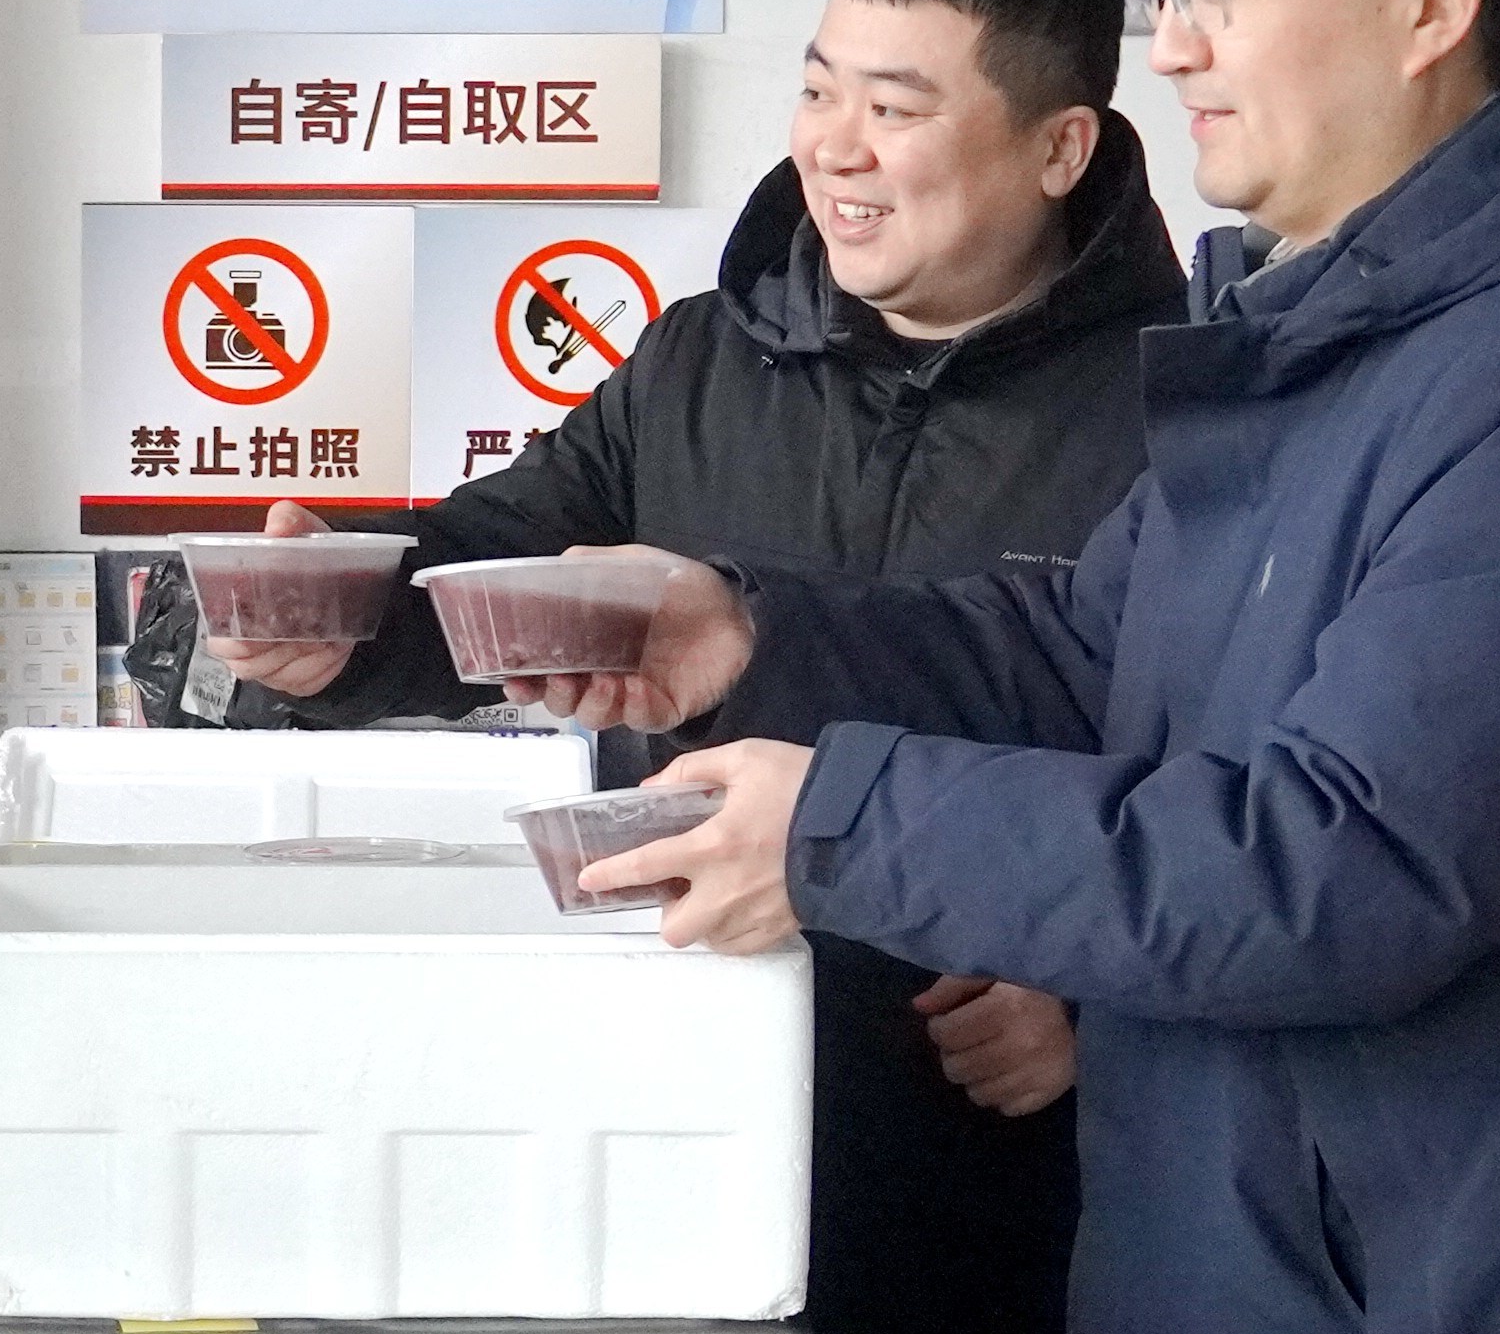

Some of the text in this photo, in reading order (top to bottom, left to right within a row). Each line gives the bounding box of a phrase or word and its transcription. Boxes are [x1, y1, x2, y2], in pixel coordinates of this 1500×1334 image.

[229, 77, 599, 152] 自寄/自取区
[130, 425, 362, 479] 禁止拍照
[462, 428, 556, 478] 严
